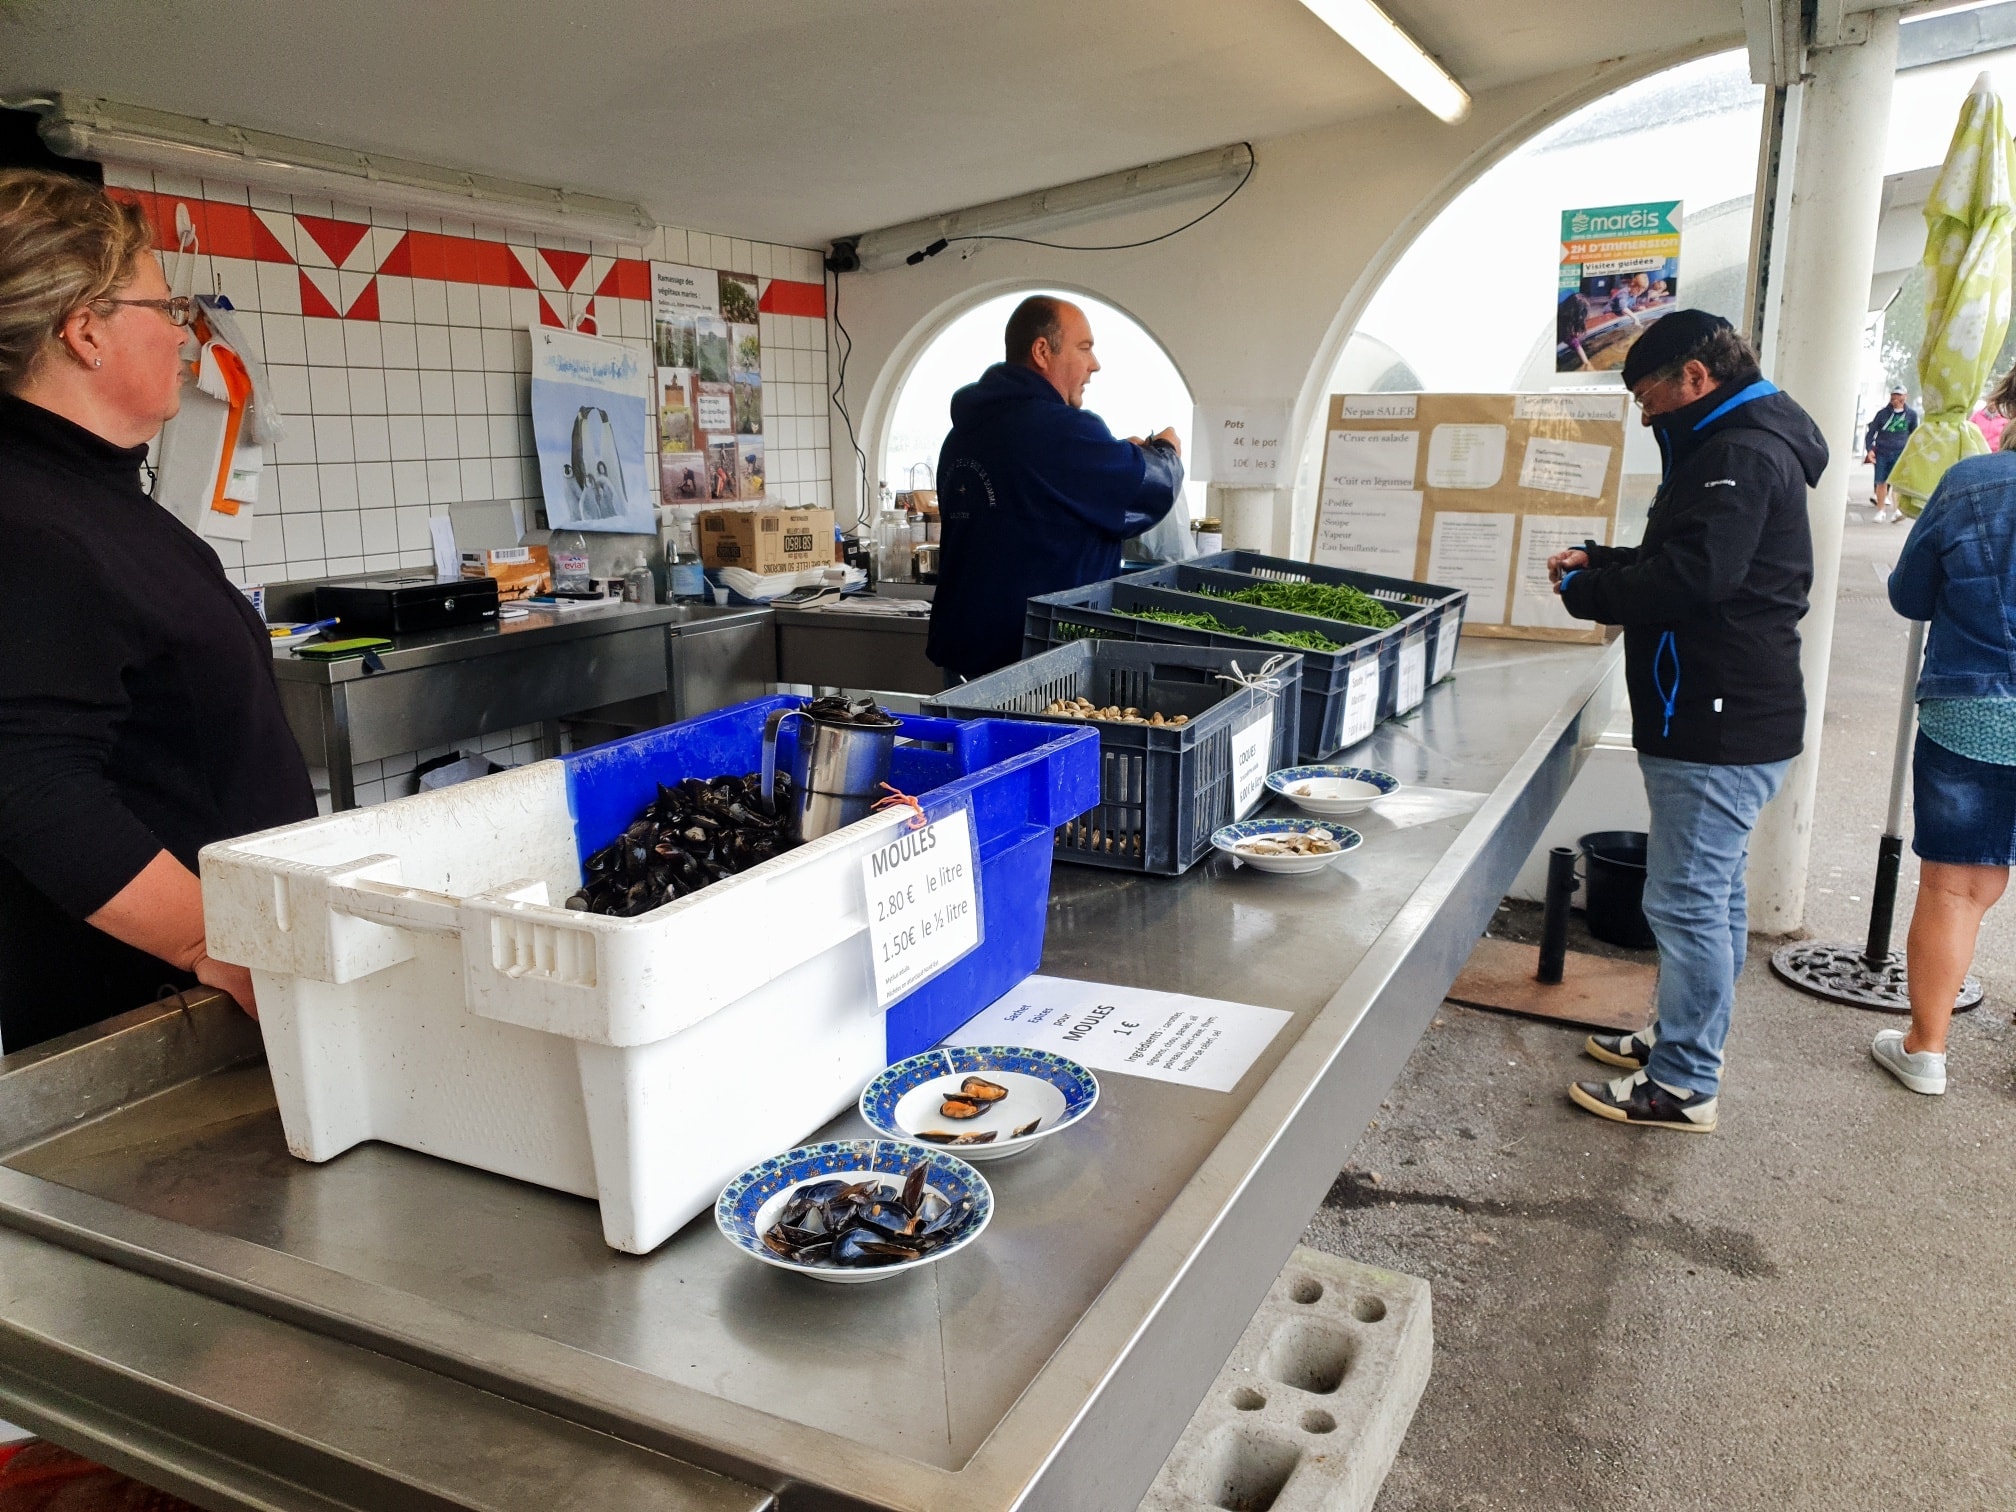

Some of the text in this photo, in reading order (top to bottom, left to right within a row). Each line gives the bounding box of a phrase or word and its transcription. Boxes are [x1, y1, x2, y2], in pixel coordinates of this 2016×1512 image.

[1586, 262, 1615, 271] Visites
[1618, 257, 1654, 268] guidées
[657, 273, 694, 286] Ramassage des
[657, 287, 680, 297] végétaux
[681, 291, 698, 299] marins
[1344, 406, 1415, 418] Ne pas SALER
[1224, 420, 1245, 429] Pots
[1251, 437, 1260, 447] le
[1262, 439, 1278, 448] pot
[1367, 435, 1380, 443] en
[1381, 434, 1410, 443] salade
[1255, 459, 1268, 468] les
[1269, 459, 1276, 468] 3
[1360, 478, 1372, 486] en
[1374, 477, 1413, 489] légumes
[1339, 544, 1379, 554] bouillante
[564, 561, 586, 570] evian
[763, 562, 787, 574] MICRONS
[871, 824, 937, 878] MOULES
[925, 874, 937, 894] le
[938, 862, 963, 888] litre
[920, 919, 932, 939] le
[946, 899, 968, 925] litre
[1004, 1004, 1032, 1022] Sachet
[1028, 1007, 1054, 1025] Epices
[1052, 1013, 1072, 1027] pour
[1062, 1004, 1116, 1042] MOULES
[1211, 1029, 1223, 1037] sel
